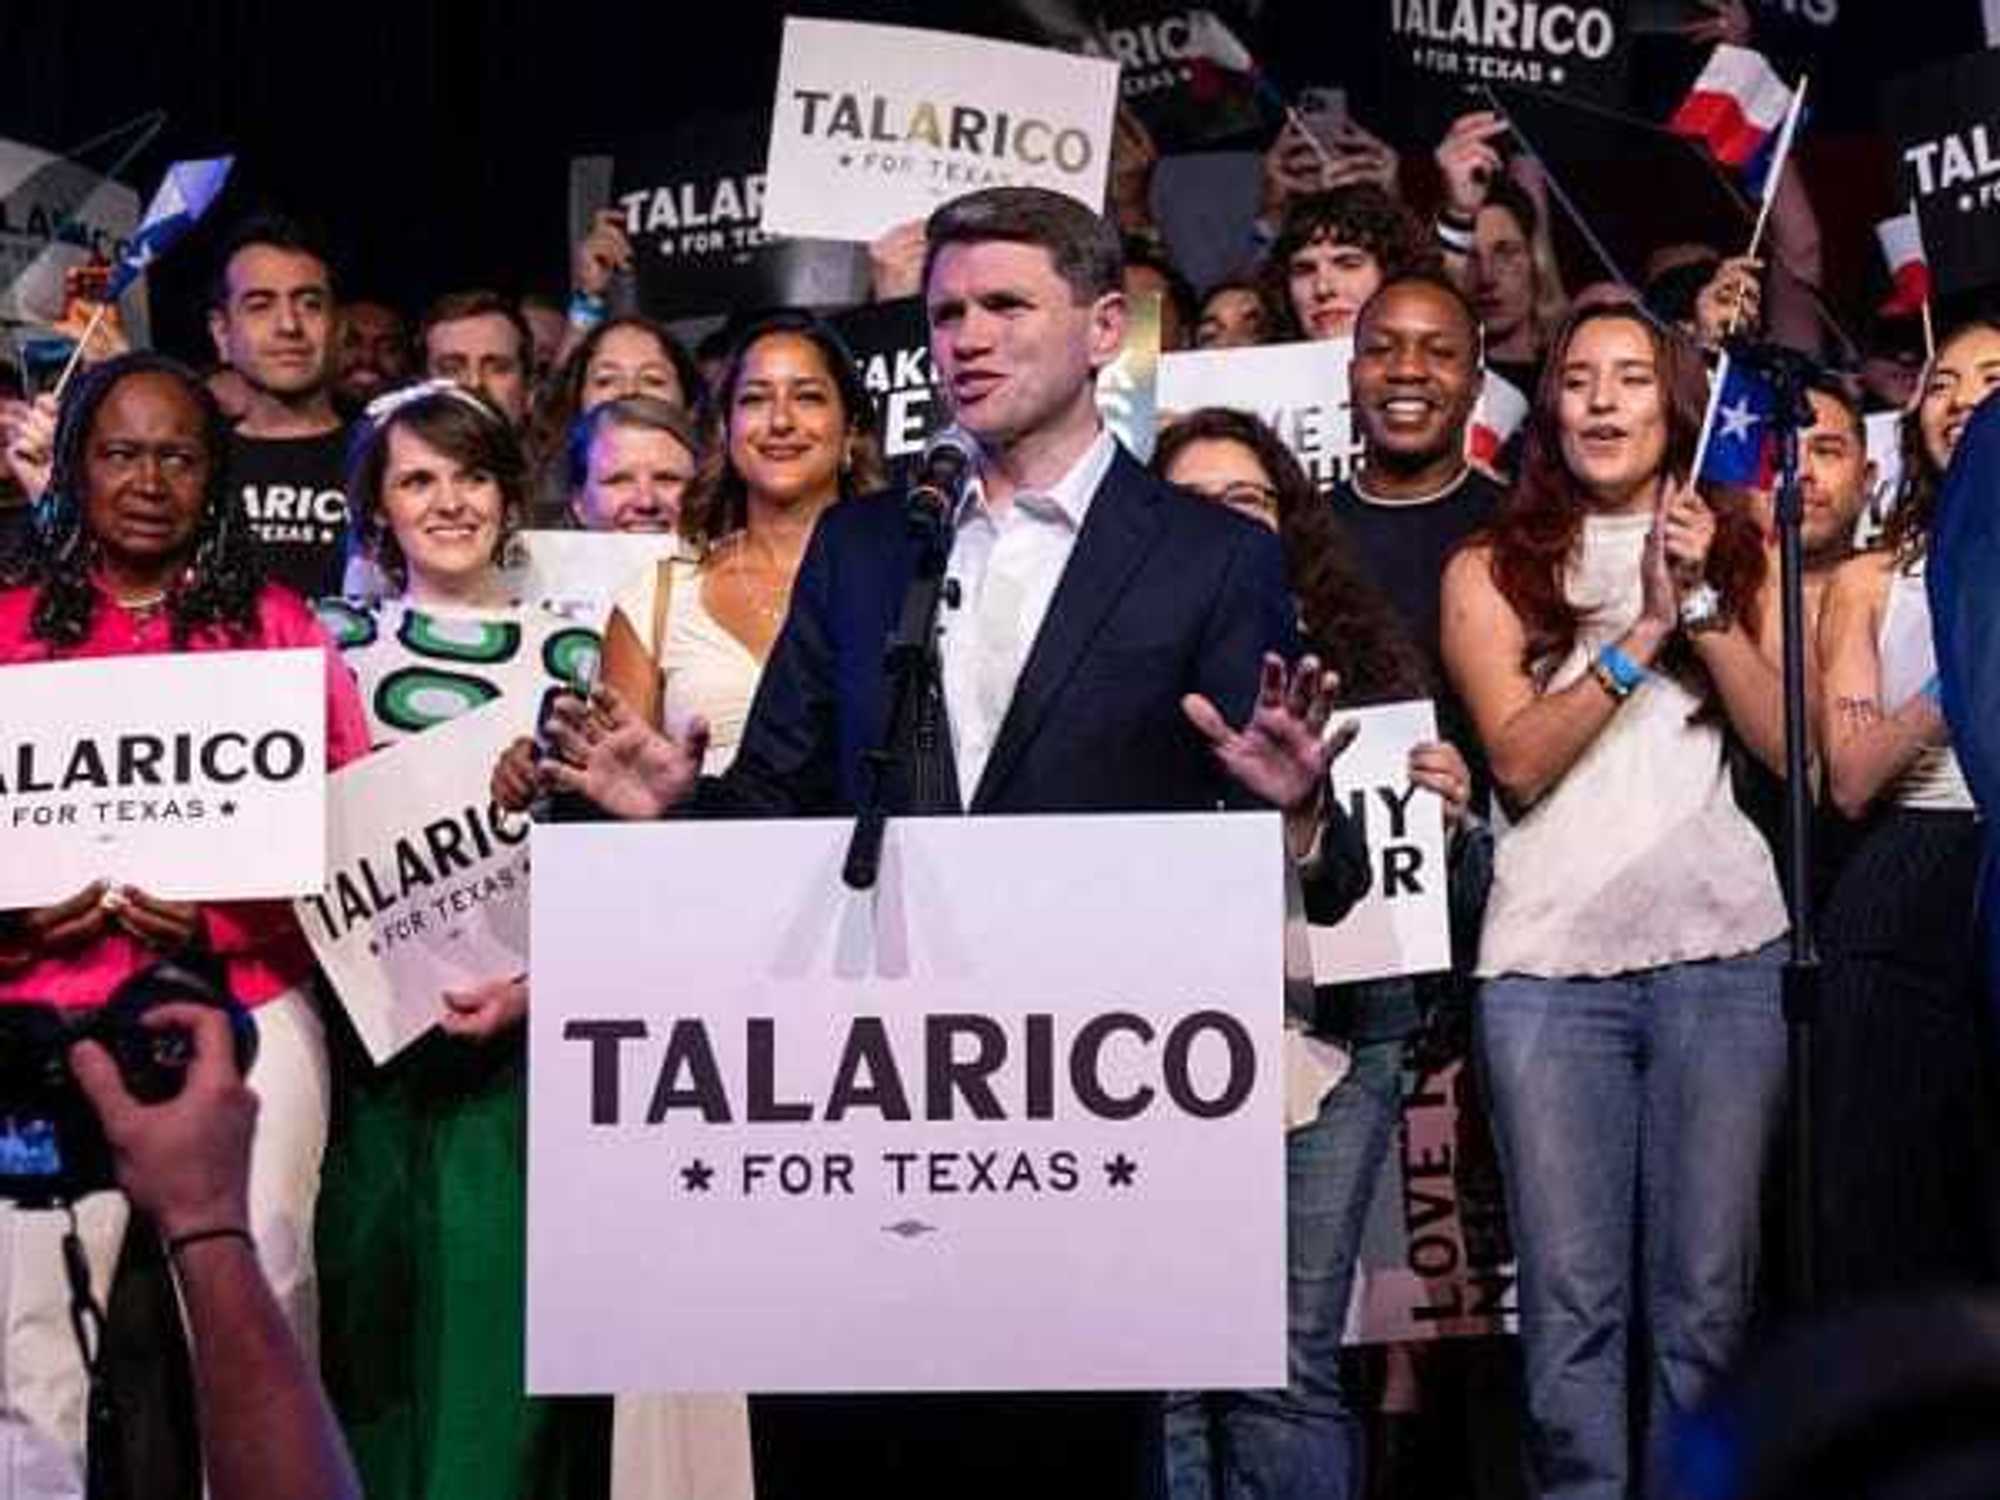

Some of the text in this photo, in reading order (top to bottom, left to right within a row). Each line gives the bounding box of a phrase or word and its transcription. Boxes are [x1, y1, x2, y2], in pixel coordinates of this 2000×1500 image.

[1465, 55, 1542, 82] TEXAS
[794, 89, 1092, 175] TALARICO
[13, 799, 204, 827] FOR TEXAS
[384, 867, 515, 948] FOR TEXAS
[563, 1009, 1257, 1125] TALARICO
[742, 1151, 1080, 1195] FOR TEXAS
[1408, 1143, 1466, 1322] LOVE
